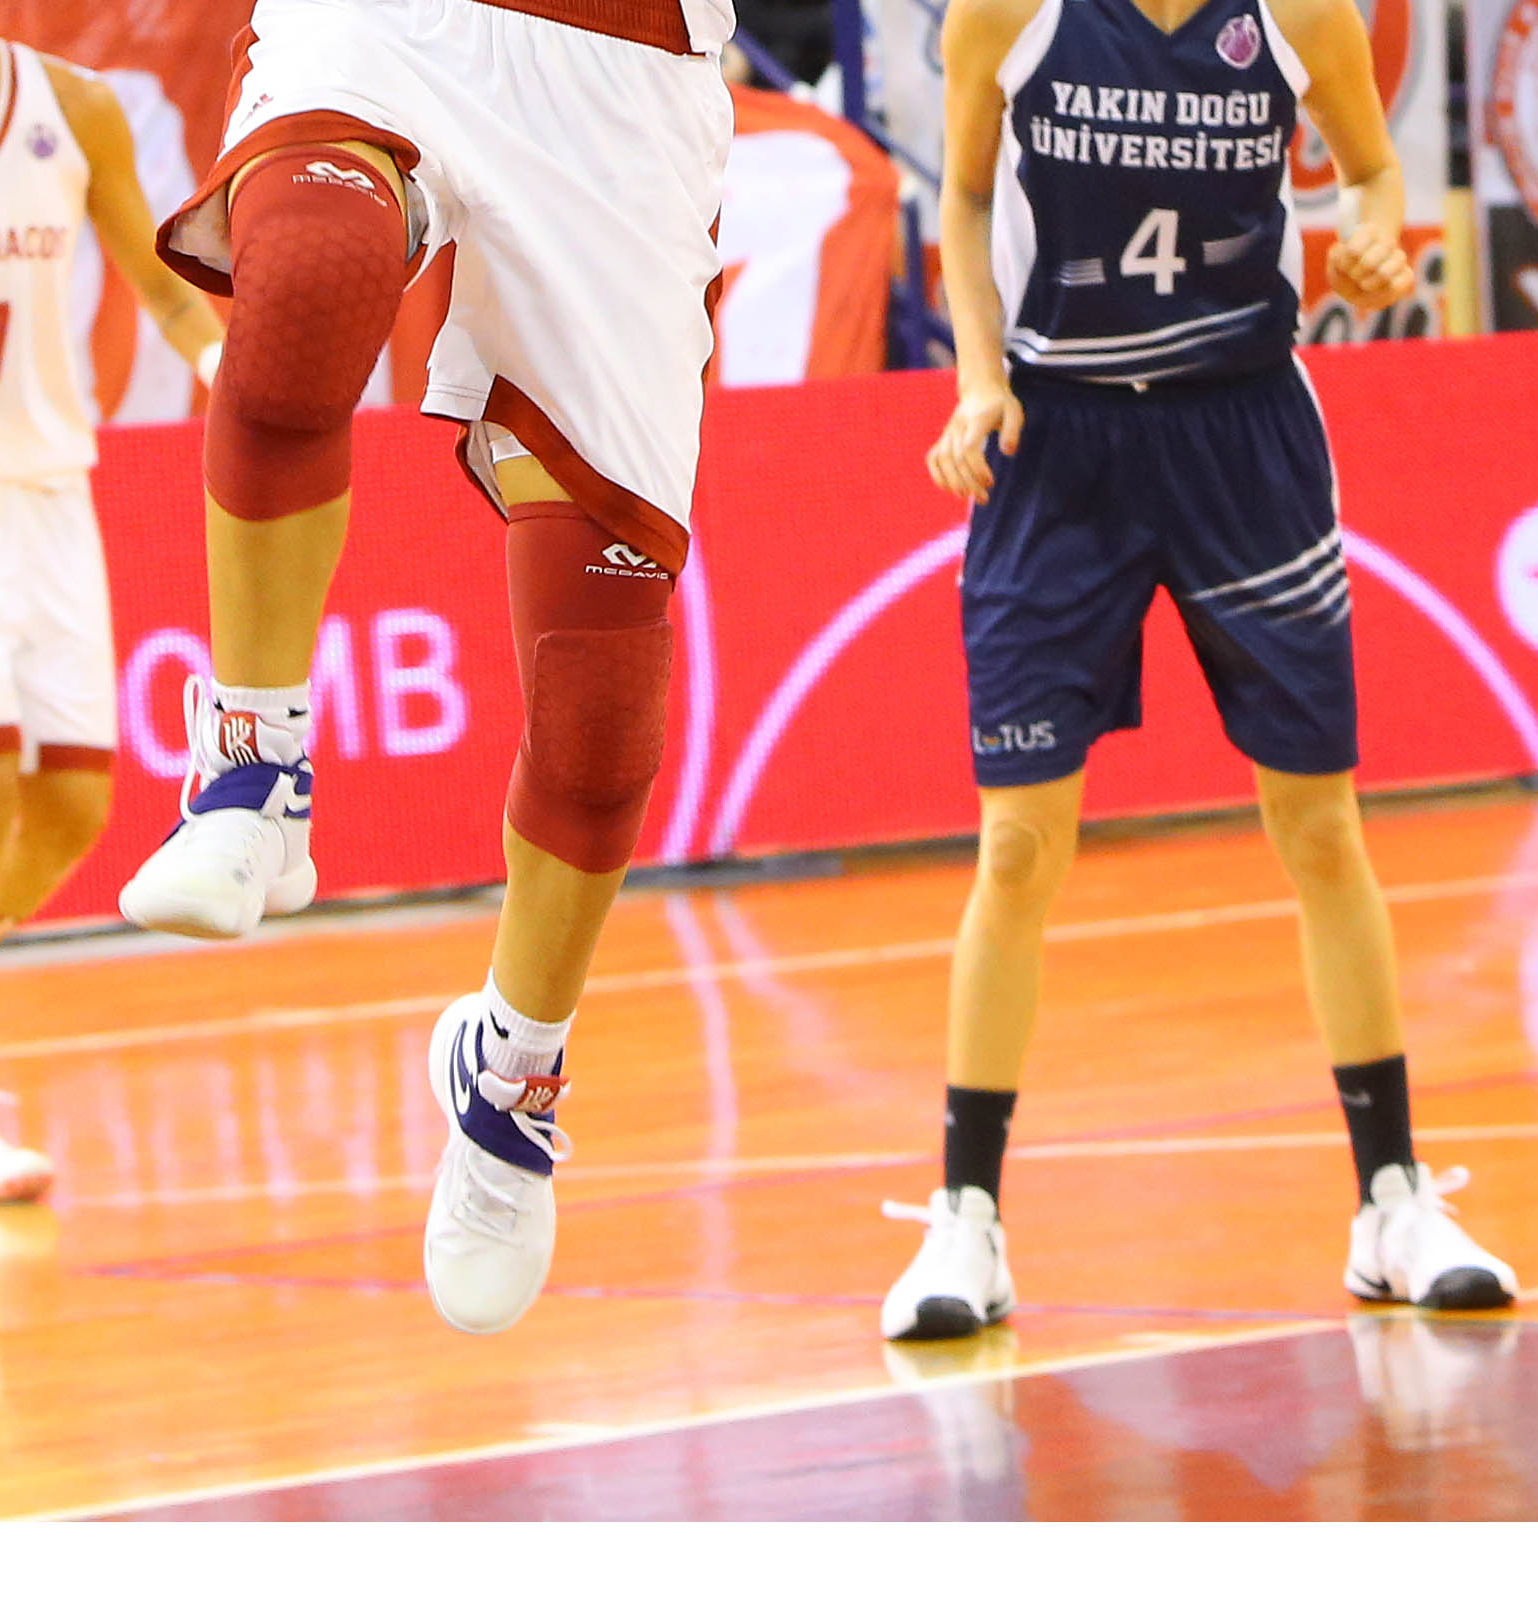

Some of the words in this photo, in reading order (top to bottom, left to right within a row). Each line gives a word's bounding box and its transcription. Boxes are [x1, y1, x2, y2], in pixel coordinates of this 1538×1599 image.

[1051, 80, 1168, 125] YAKIN
[1175, 89, 1271, 127] DOĞU
[1030, 115, 1284, 171] ÜNİVERSİTESİ
[1119, 208, 1188, 296] 4
